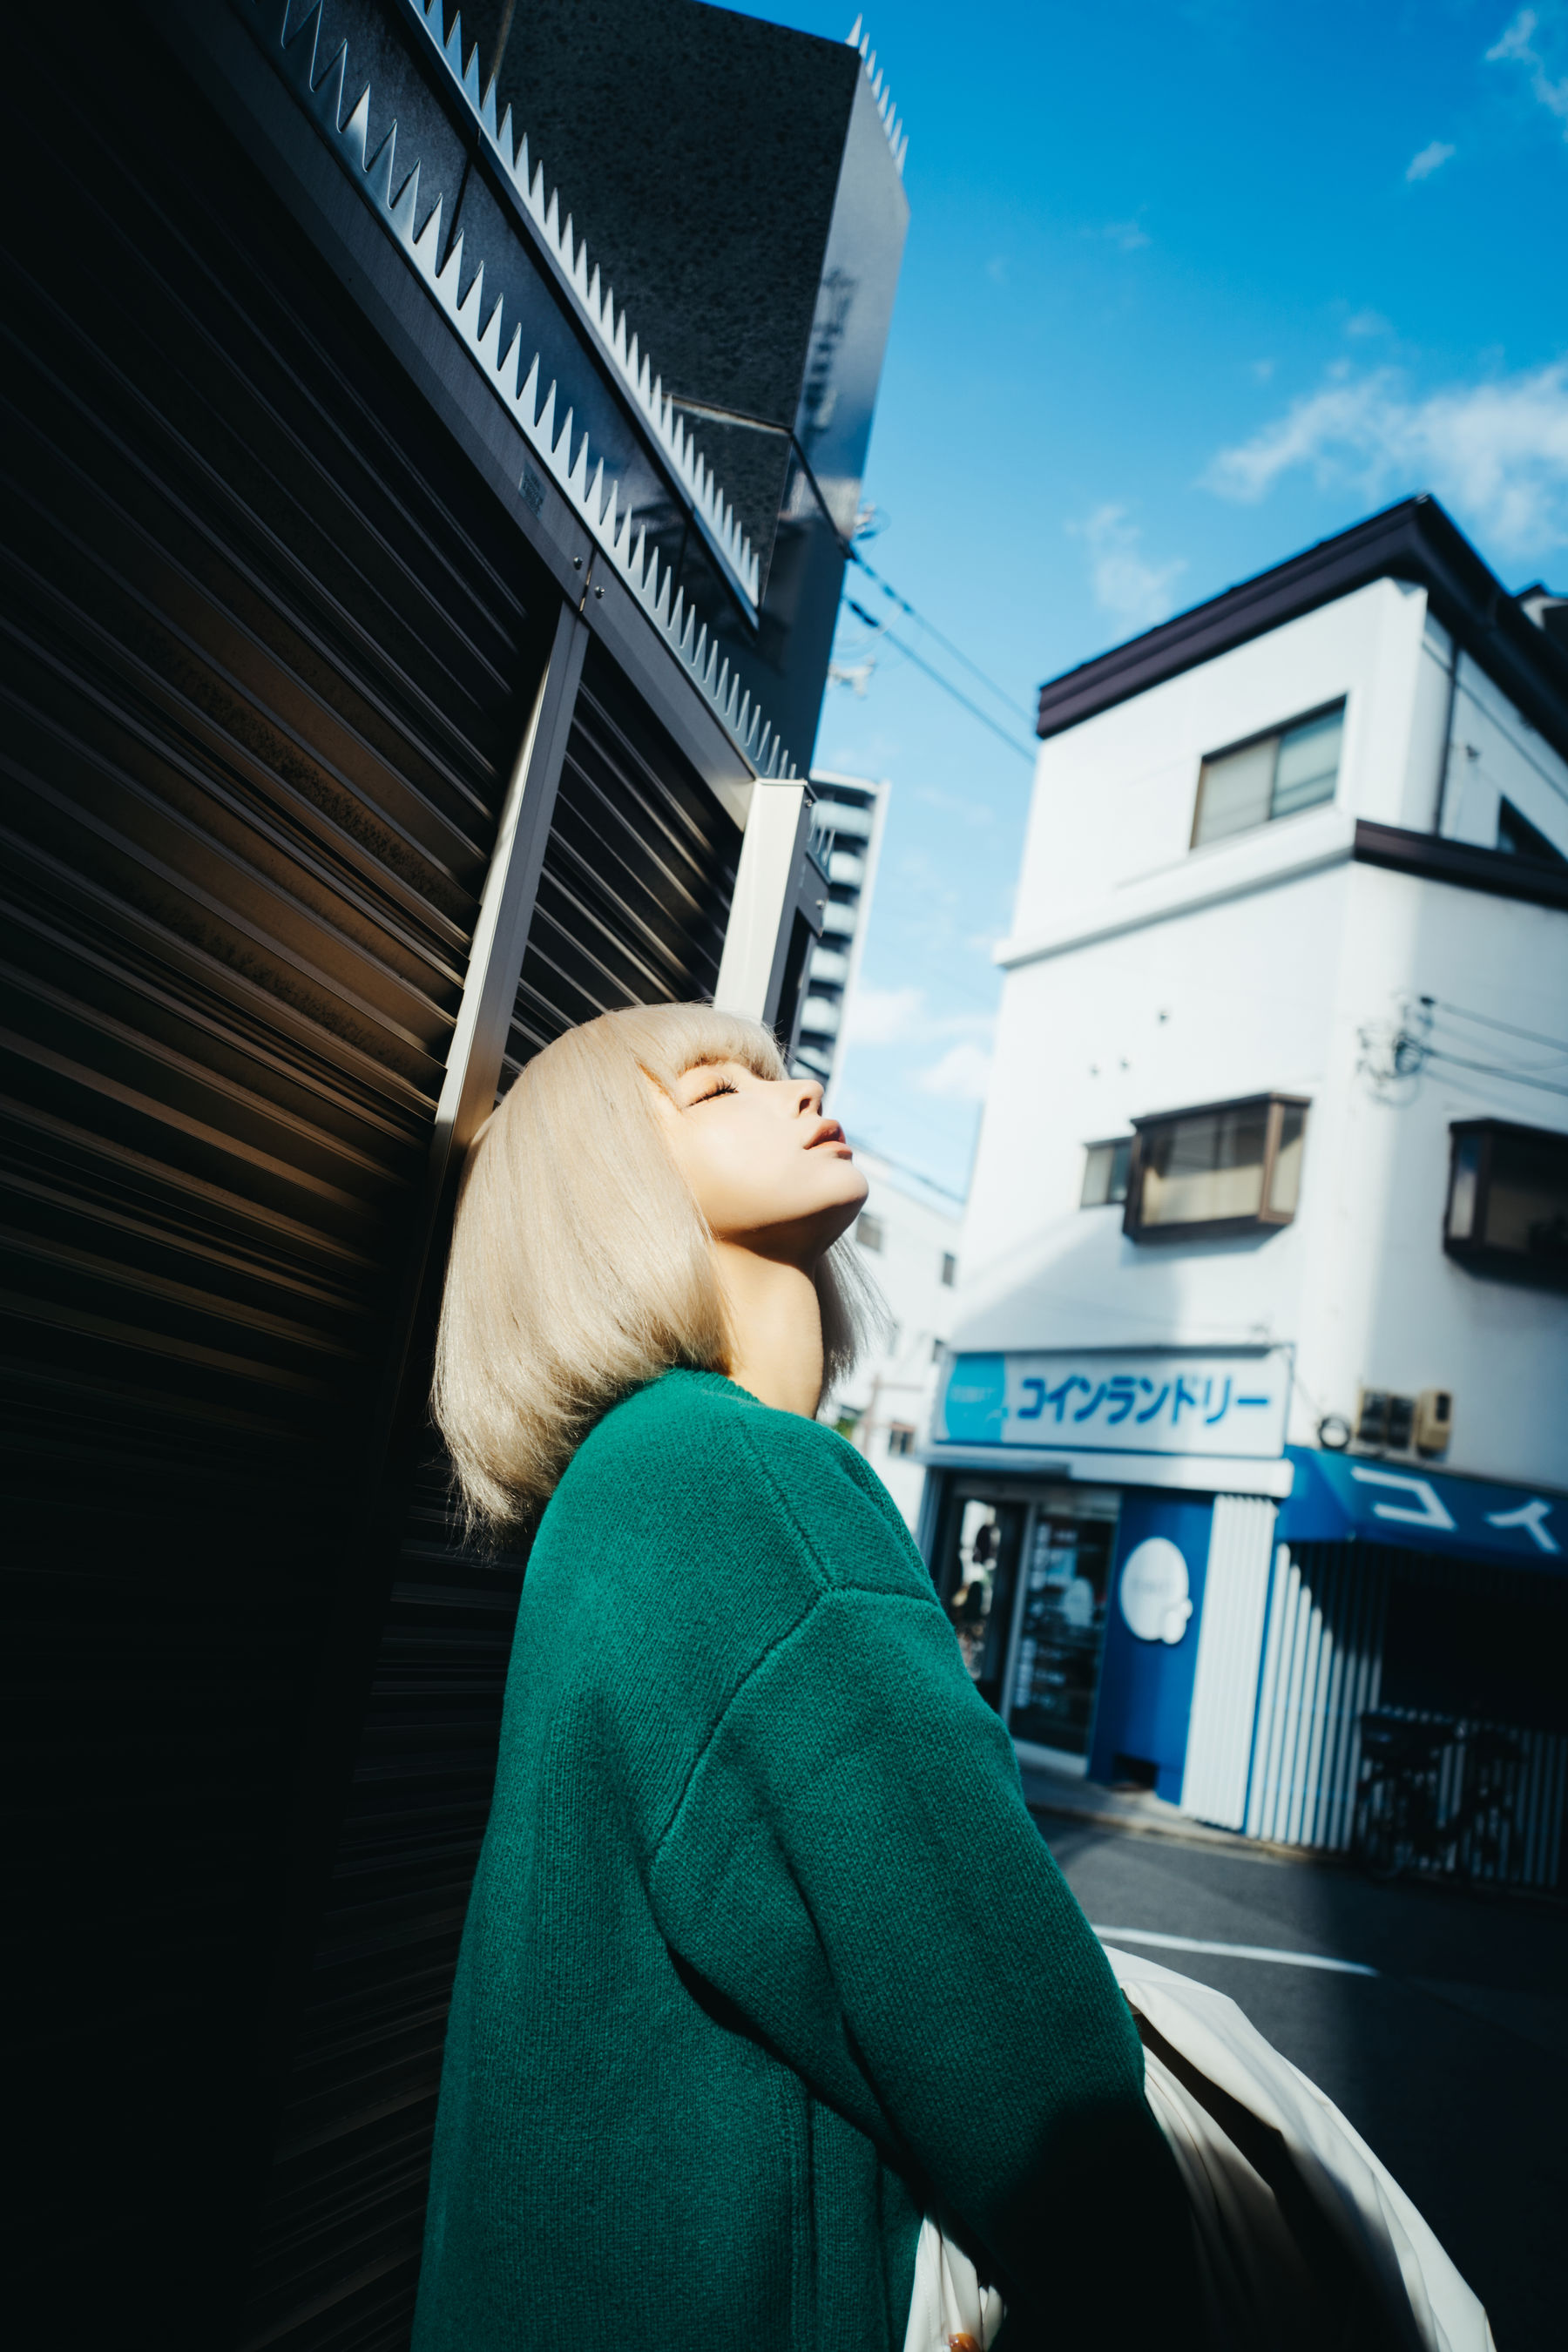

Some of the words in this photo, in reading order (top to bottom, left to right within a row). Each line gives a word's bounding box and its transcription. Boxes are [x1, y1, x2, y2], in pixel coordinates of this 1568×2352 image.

[1017, 1374, 1269, 1425] コインランドリー
[1352, 1466, 1558, 1552] コイ
